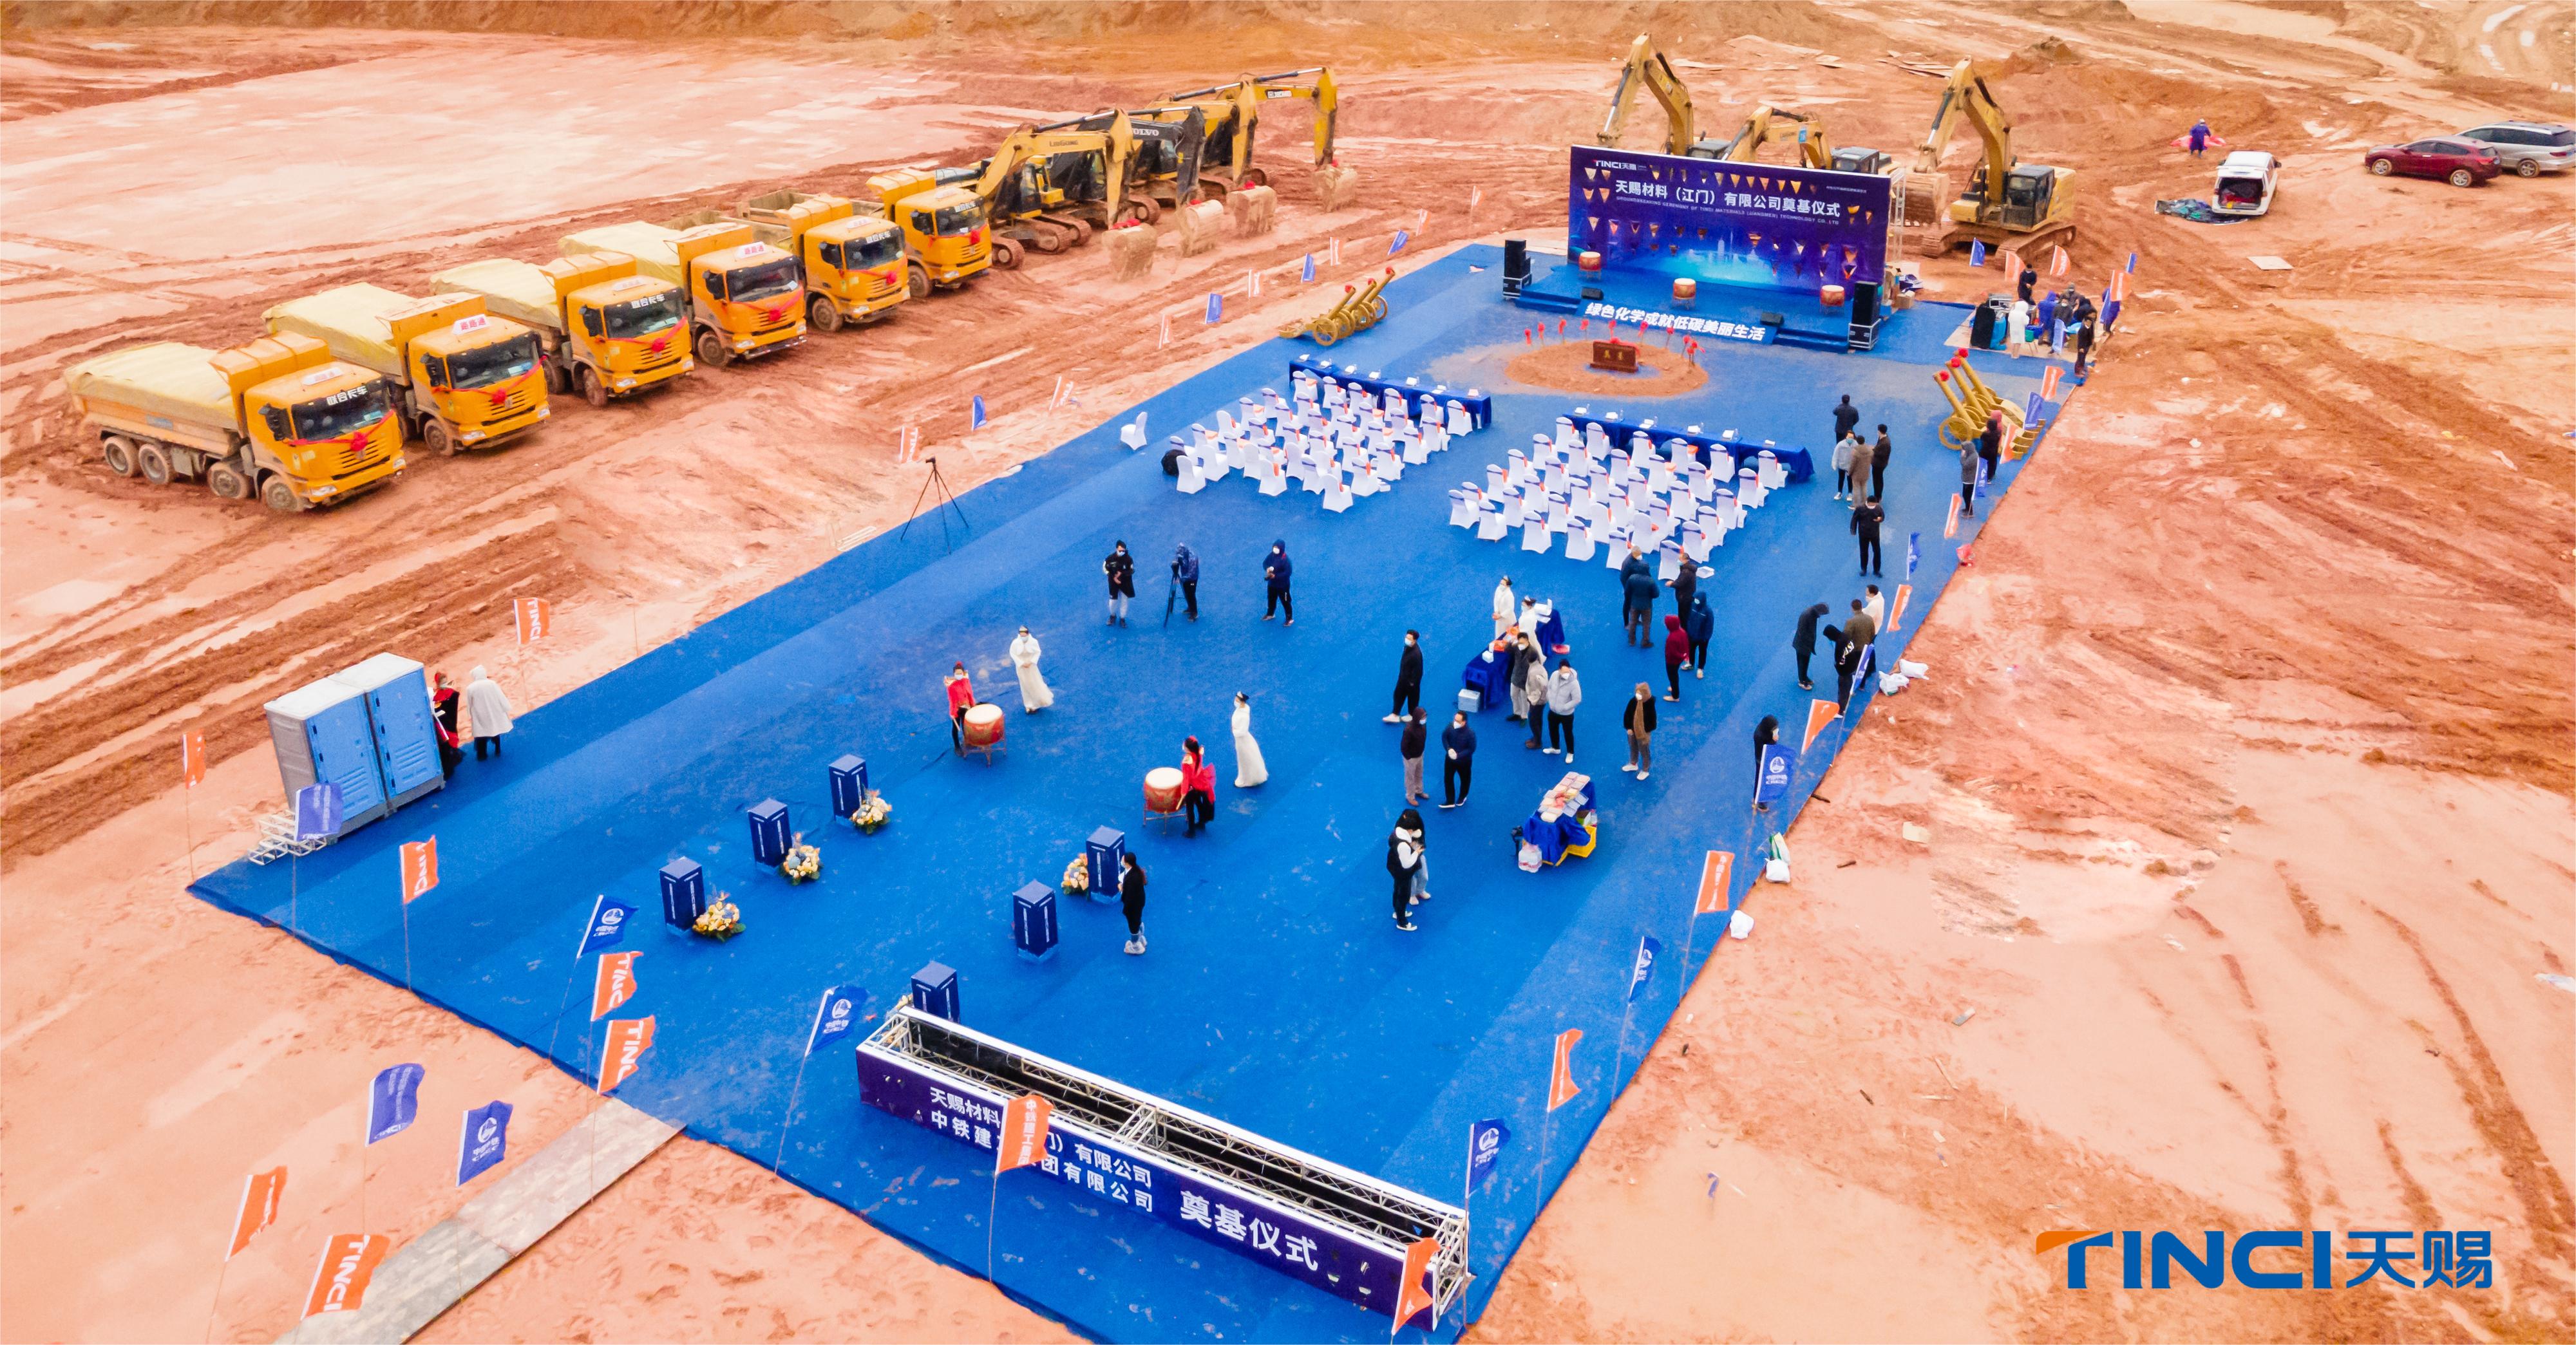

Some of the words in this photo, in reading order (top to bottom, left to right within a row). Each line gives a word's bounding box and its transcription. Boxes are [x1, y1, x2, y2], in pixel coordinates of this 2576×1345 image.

[1133, 128, 1159, 136] OLVO
[1585, 303, 1766, 341] 绿色化学成就低碳美丽生活
[1180, 1190, 1319, 1272] 奠基仪式
[323, 1235, 371, 1312] TINCI
